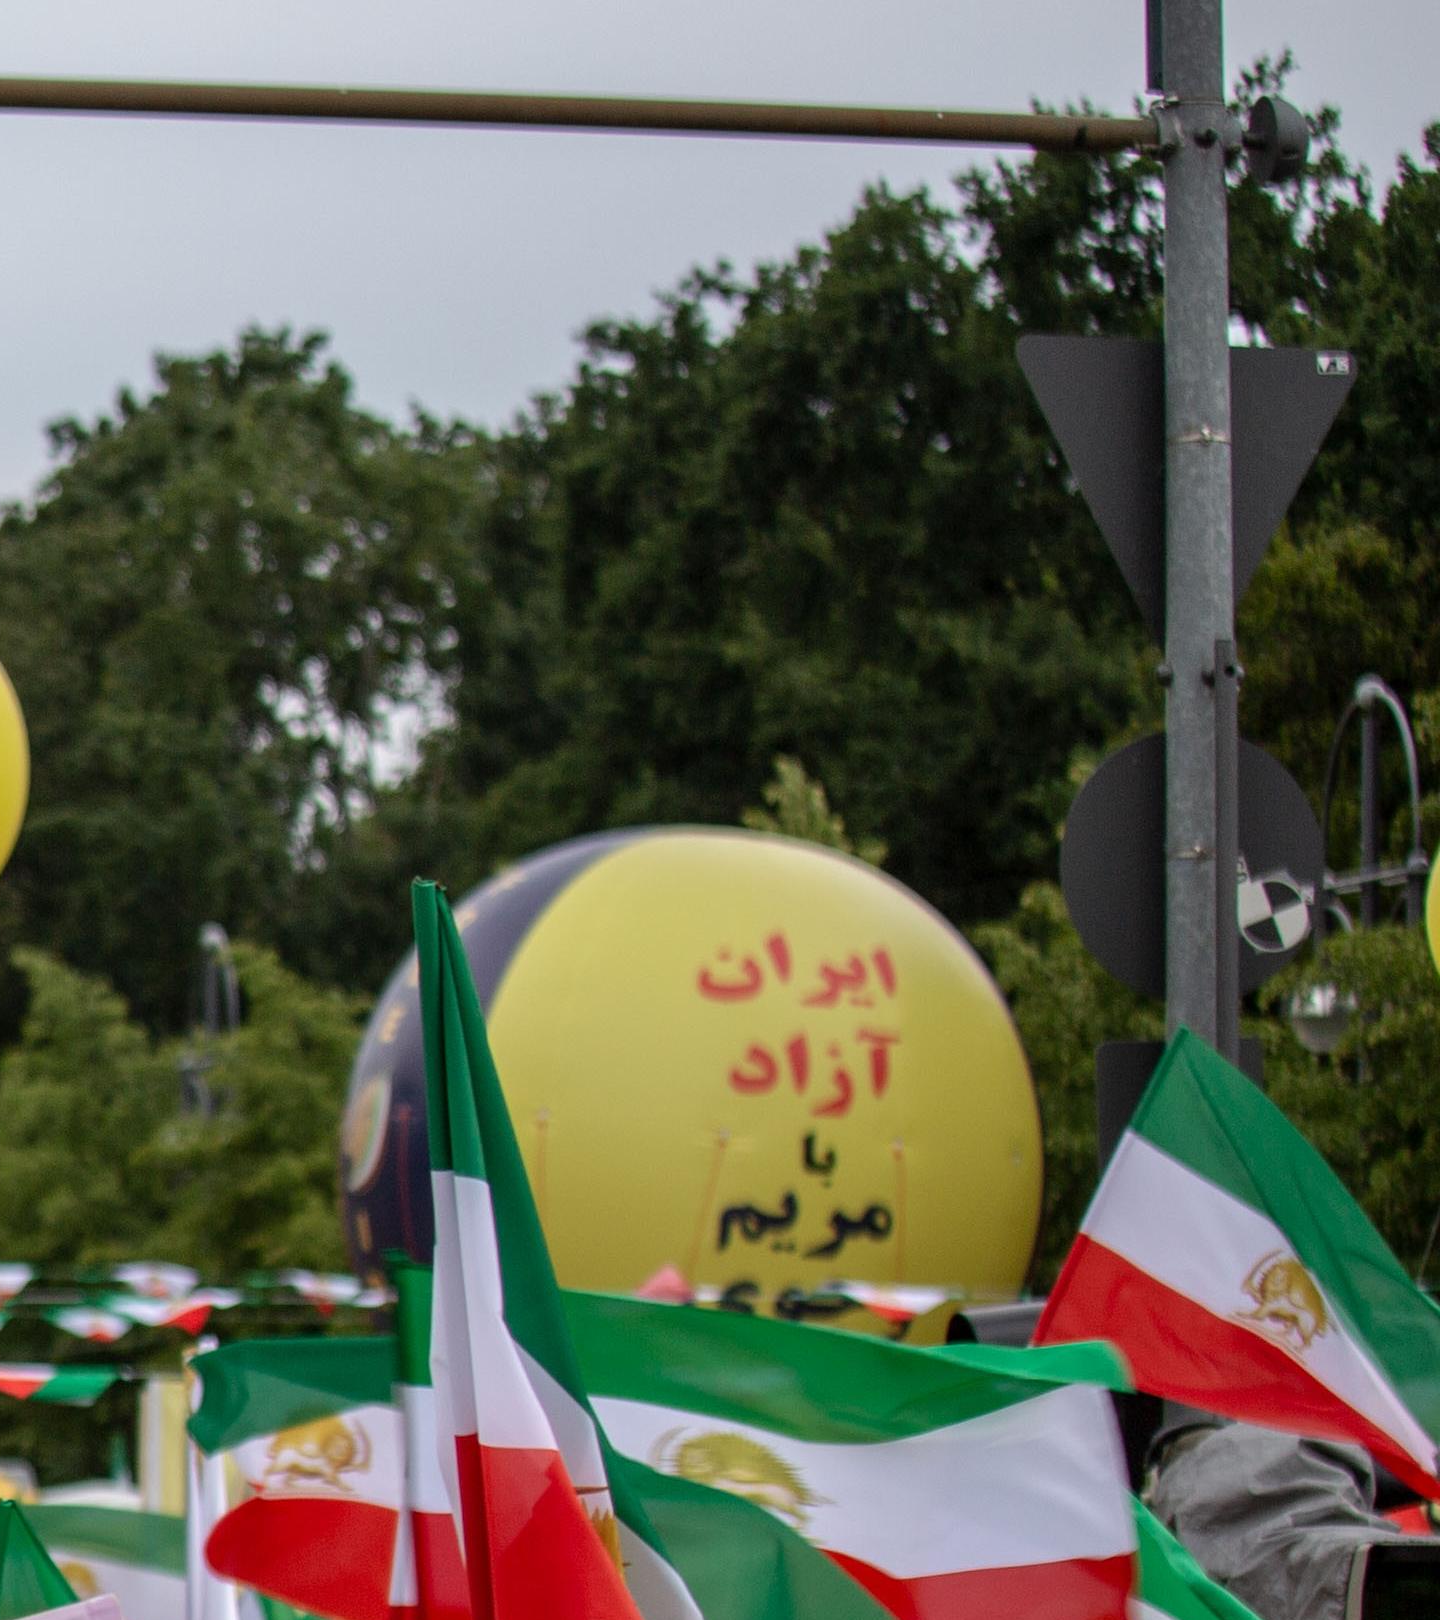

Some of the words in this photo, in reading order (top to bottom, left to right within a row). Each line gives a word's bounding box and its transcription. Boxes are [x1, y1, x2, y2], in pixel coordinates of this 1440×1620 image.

[696, 931, 898, 1008] ایران
[729, 1027, 900, 1118] آزاد
[717, 1189, 892, 1259] مریم
